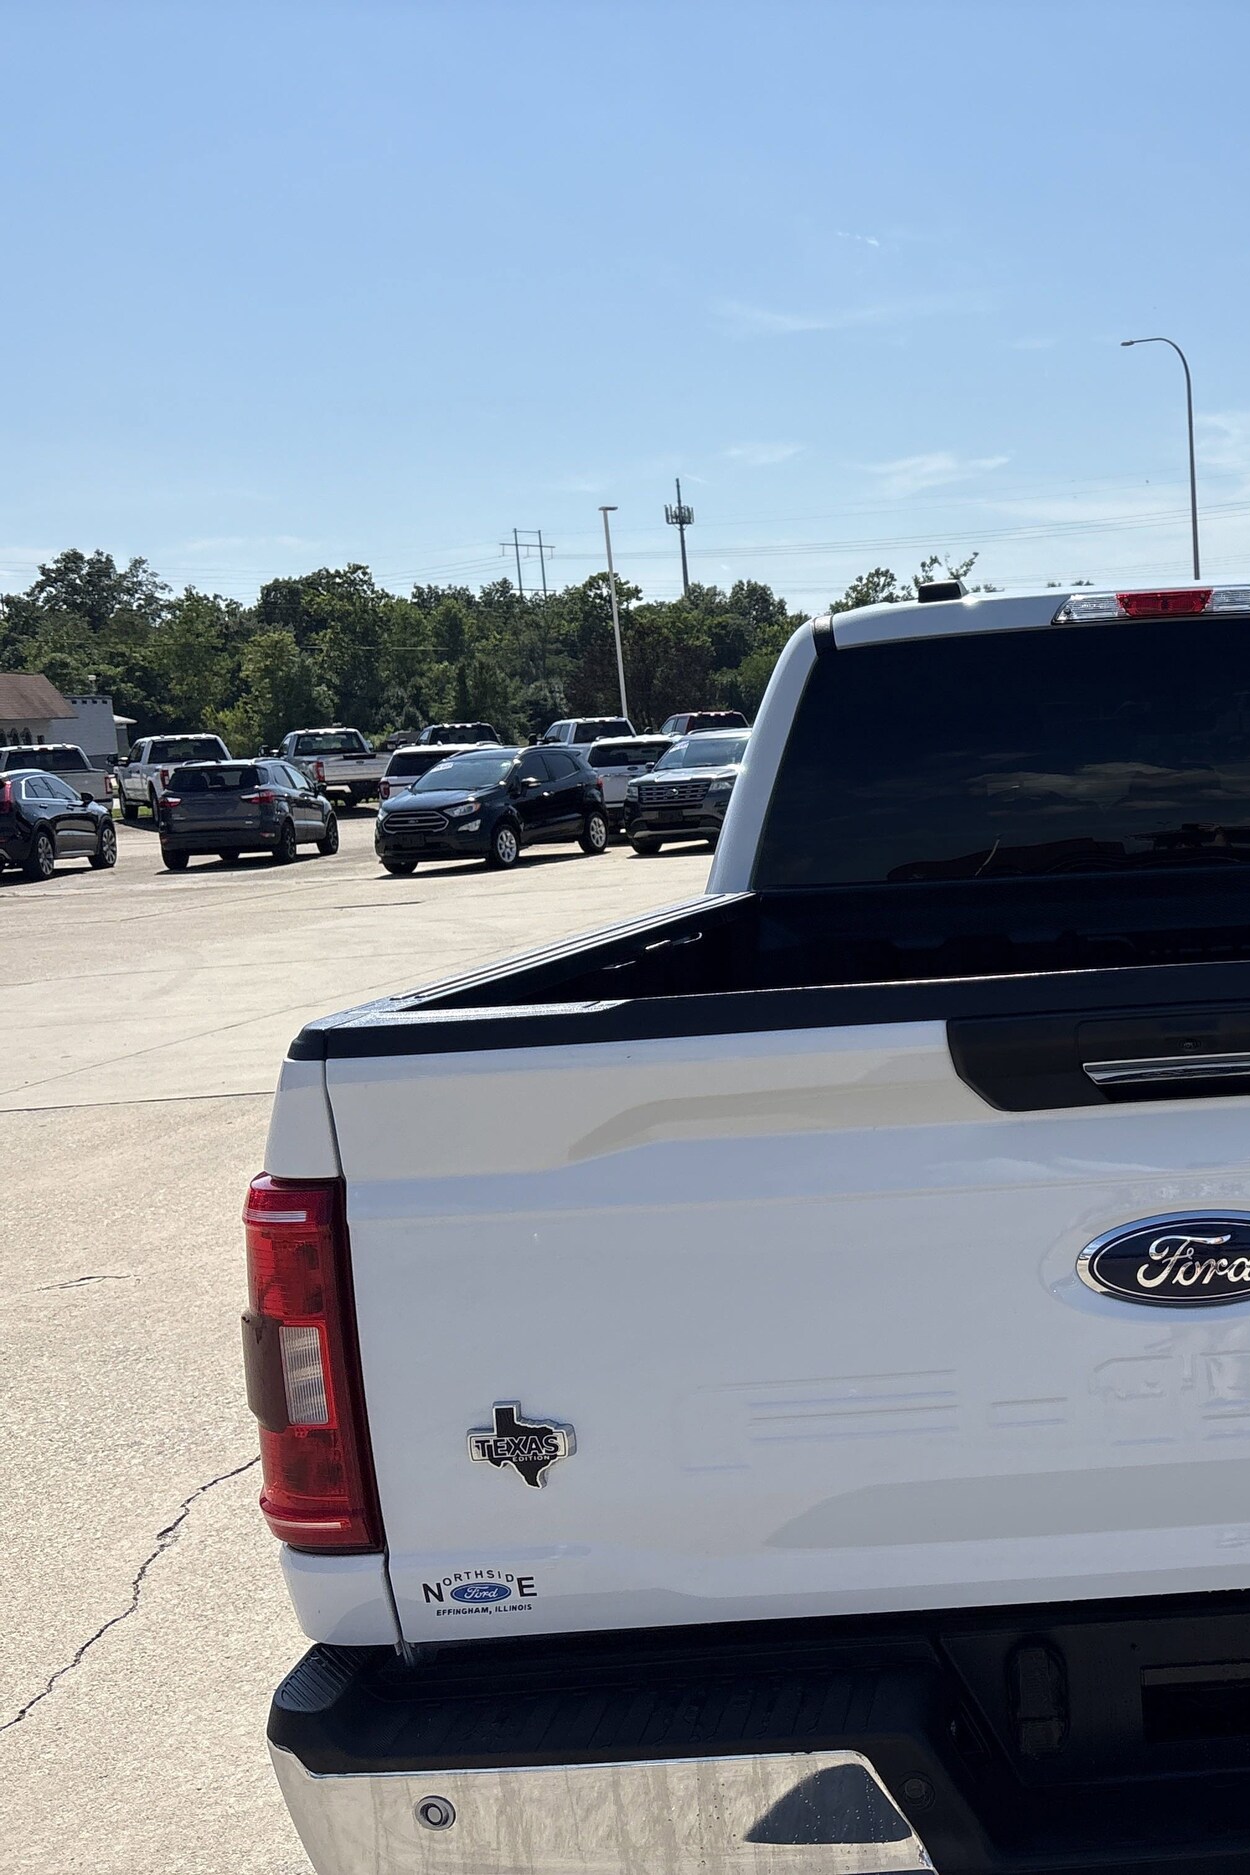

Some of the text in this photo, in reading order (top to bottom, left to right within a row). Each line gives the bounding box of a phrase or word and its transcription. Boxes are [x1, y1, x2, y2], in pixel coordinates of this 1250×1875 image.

[475, 1435, 559, 1459] TEXAS
[512, 1455, 550, 1463] EDITION
[422, 1569, 538, 1604] NORTHSIDE
[464, 1585, 499, 1599] Ford
[436, 1604, 533, 1617] EFFINGHAM, ILLINOIS
